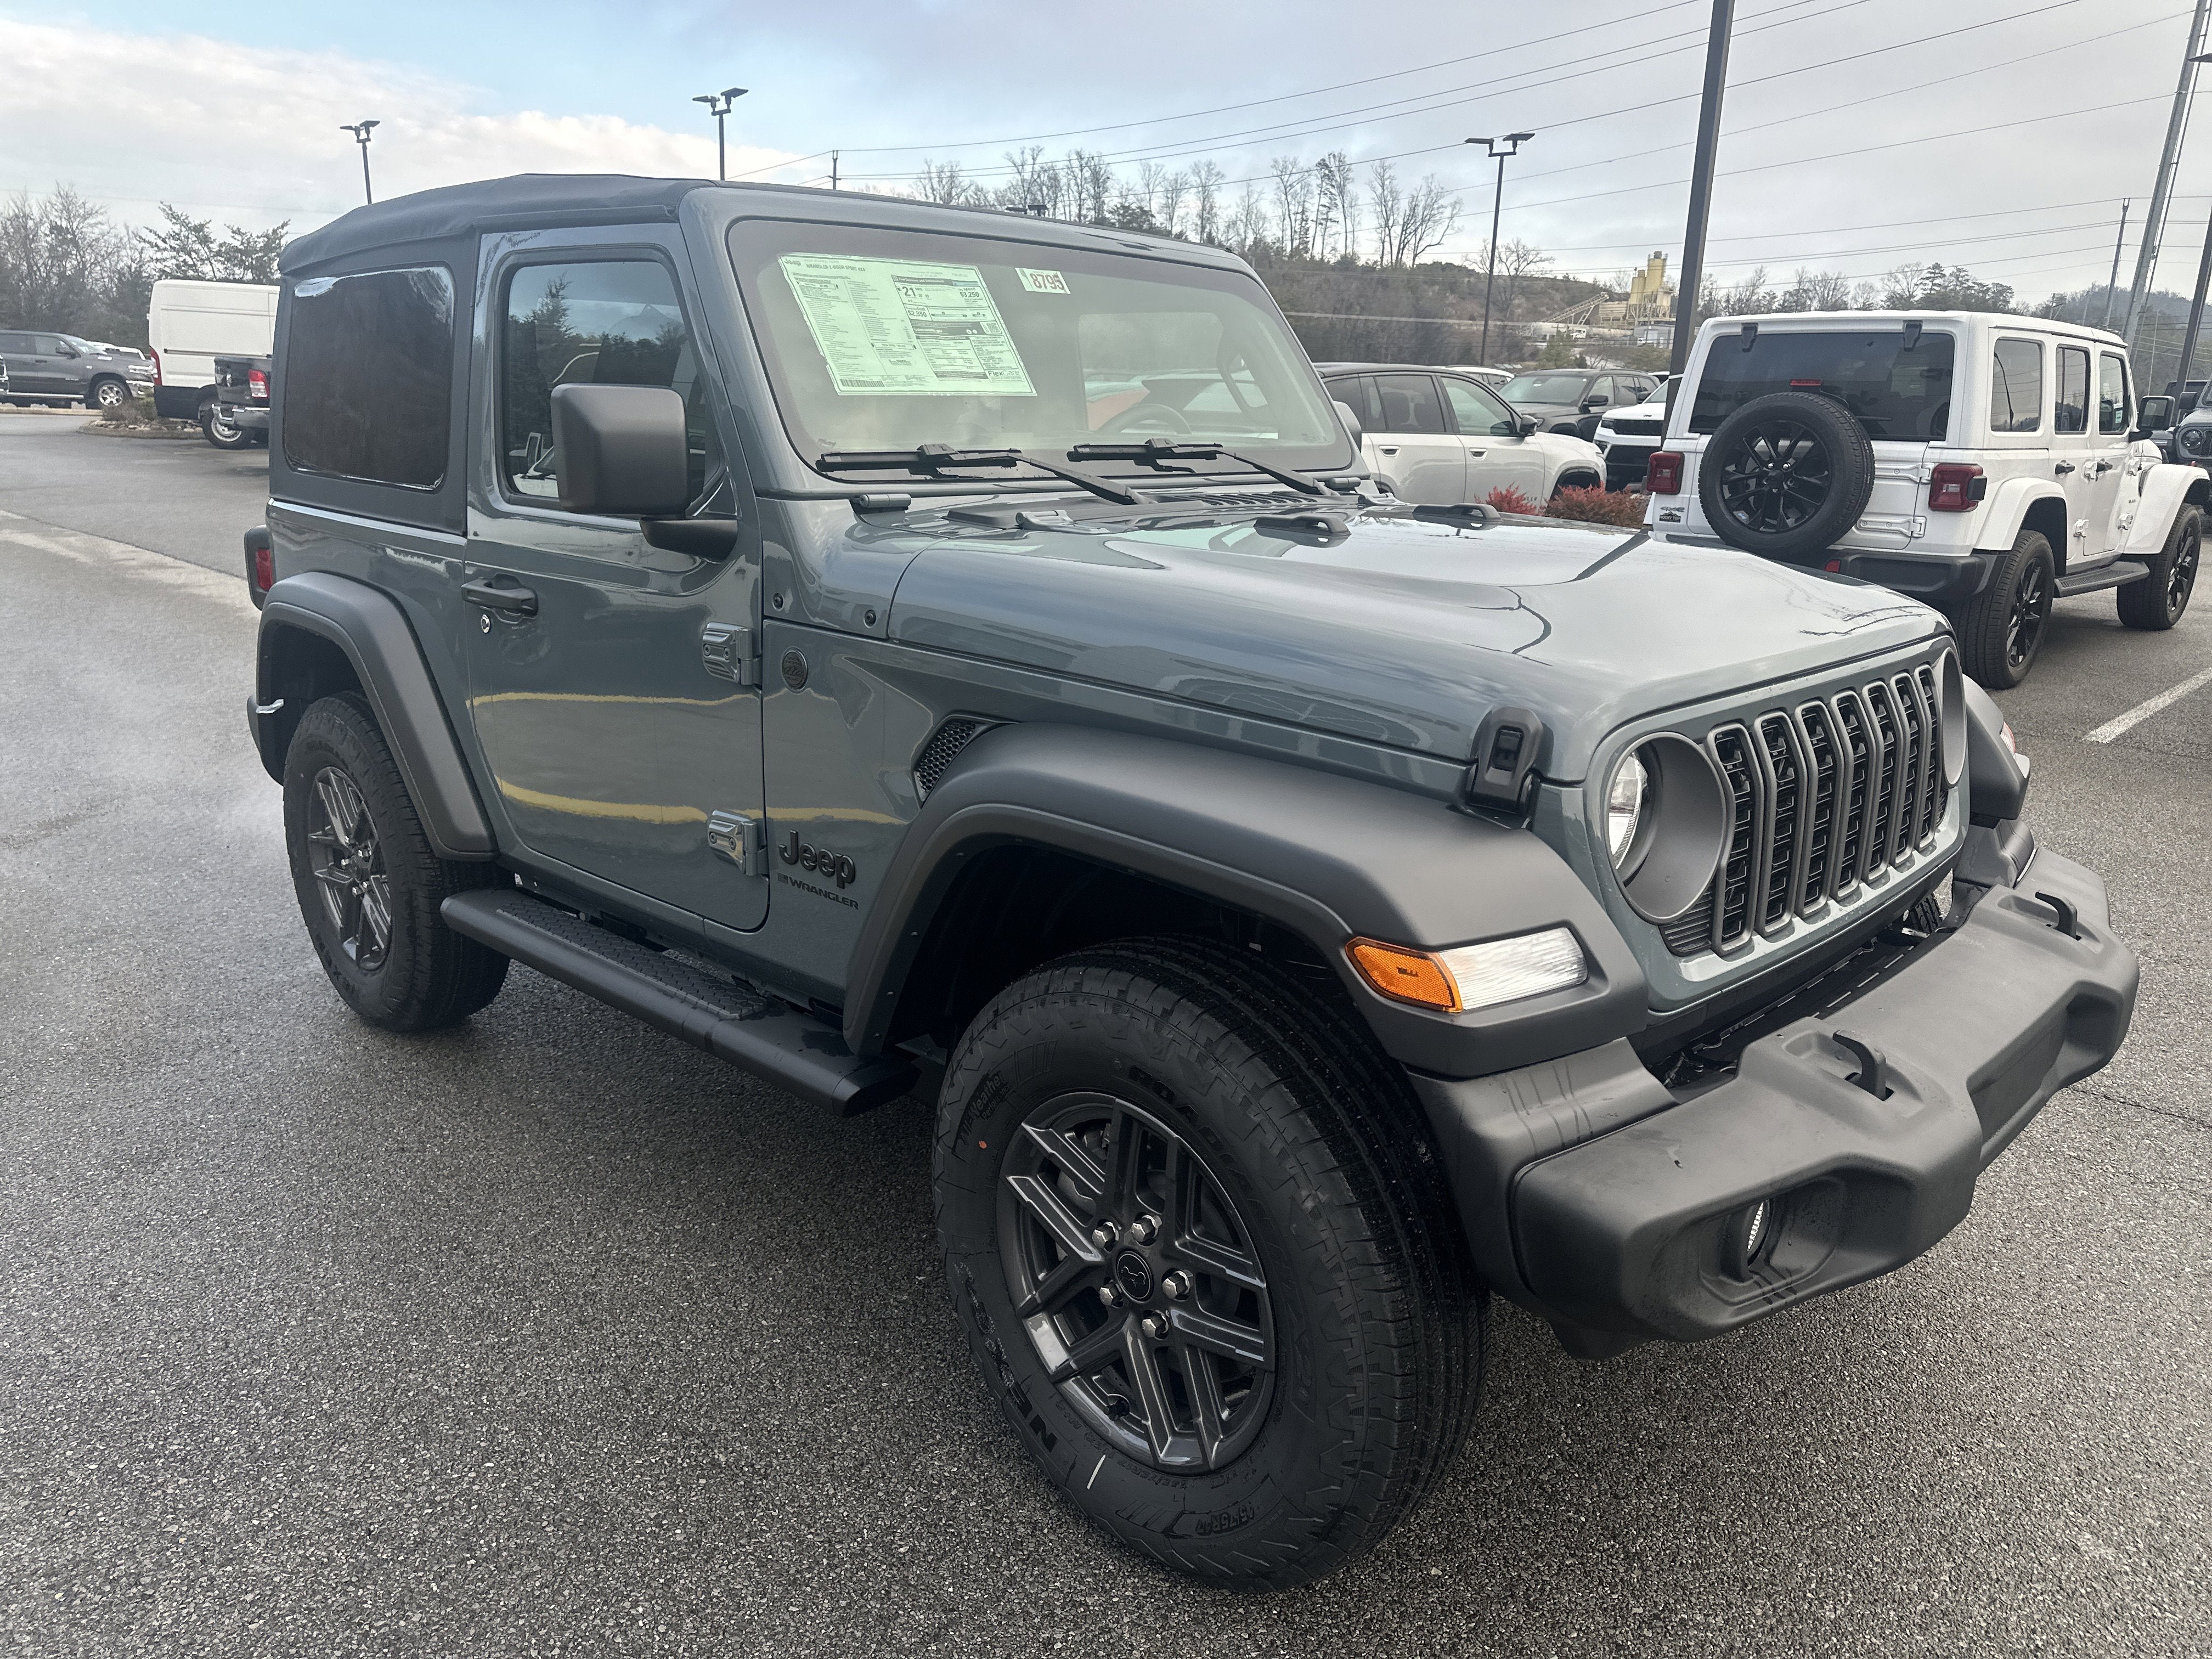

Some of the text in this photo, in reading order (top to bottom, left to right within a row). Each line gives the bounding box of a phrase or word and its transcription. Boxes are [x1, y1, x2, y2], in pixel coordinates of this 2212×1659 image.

[902, 286, 916, 297] 21
[1030, 273, 1065, 290] 8795
[778, 830, 856, 889] Jeep
[788, 877, 859, 911] WRANGLER
